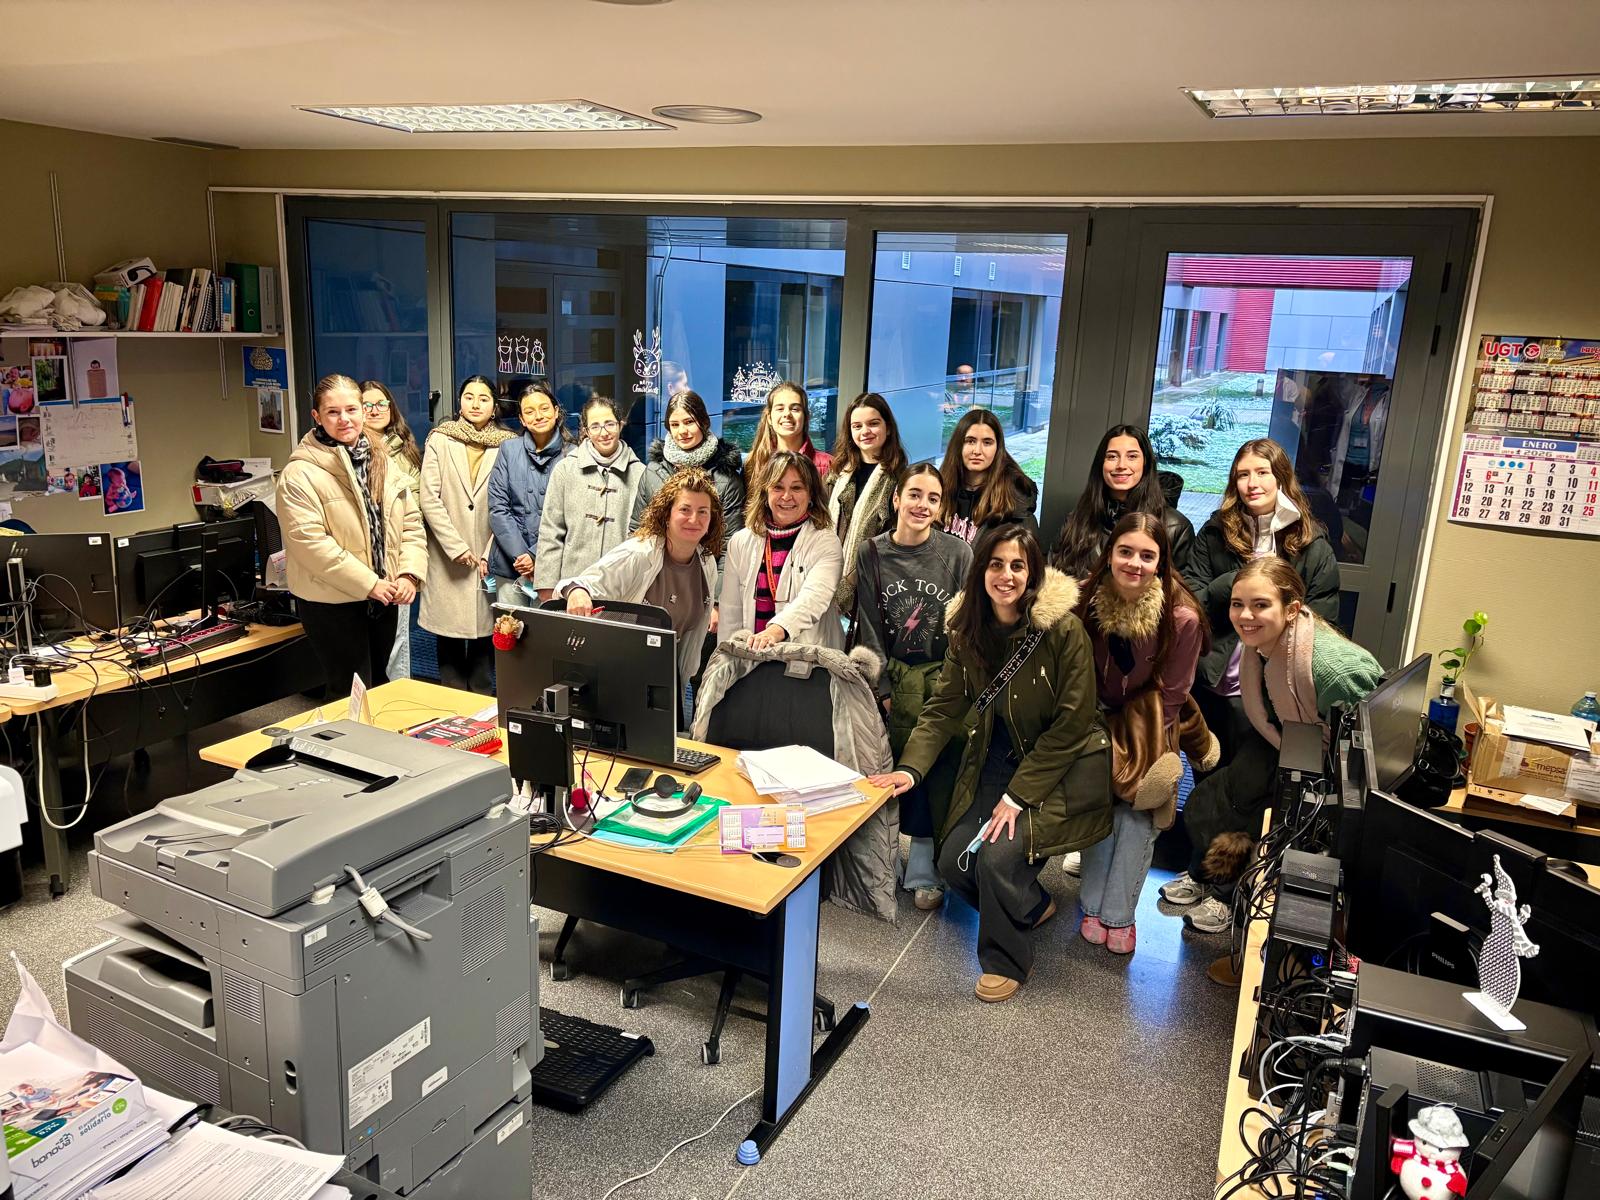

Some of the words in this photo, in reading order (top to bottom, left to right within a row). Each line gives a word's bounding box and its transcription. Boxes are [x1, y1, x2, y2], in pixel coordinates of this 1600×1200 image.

[1486, 342, 1523, 357] UGT
[1522, 440, 1557, 450] ENERO
[1523, 450, 1553, 458] 2026
[1529, 462, 1533, 471] 1
[1550, 463, 1555, 473] 2
[1570, 465, 1575, 474] 3
[1591, 467, 1596, 476] 4
[1466, 469, 1471, 478] 5
[1486, 471, 1491, 480] 6
[1506, 473, 1512, 482] 7
[1527, 474, 1532, 484] 8
[1547, 476, 1553, 486] 9
[1568, 478, 1578, 488] 10
[1589, 481, 1598, 490] 11
[1464, 483, 1473, 492] 12
[1484, 484, 1494, 493] 13
[1505, 486, 1514, 495] 14
[1525, 488, 1535, 497] 15
[1545, 490, 1555, 499] 16
[1565, 492, 1576, 500] 17
[1586, 494, 1596, 503] 18
[1462, 495, 1470, 504] 19
[1481, 497, 1492, 506] 20
[1501, 499, 1511, 508] 21
[1522, 501, 1533, 510] 22
[1542, 502, 1553, 512] 23
[1562, 504, 1573, 514] 24
[1583, 506, 1594, 516] 25
[1459, 507, 1469, 516] 26
[1479, 509, 1490, 518] 27
[1499, 511, 1510, 520] 28
[1519, 513, 1530, 522] 29
[1540, 515, 1550, 524] 30
[1560, 517, 1570, 526] 31
[877, 579, 908, 609] OCK
[1000, 654, 1022, 680] JEANS
[1432, 952, 1454, 968] PHILIPS
[80, 1112, 112, 1136] solidario
